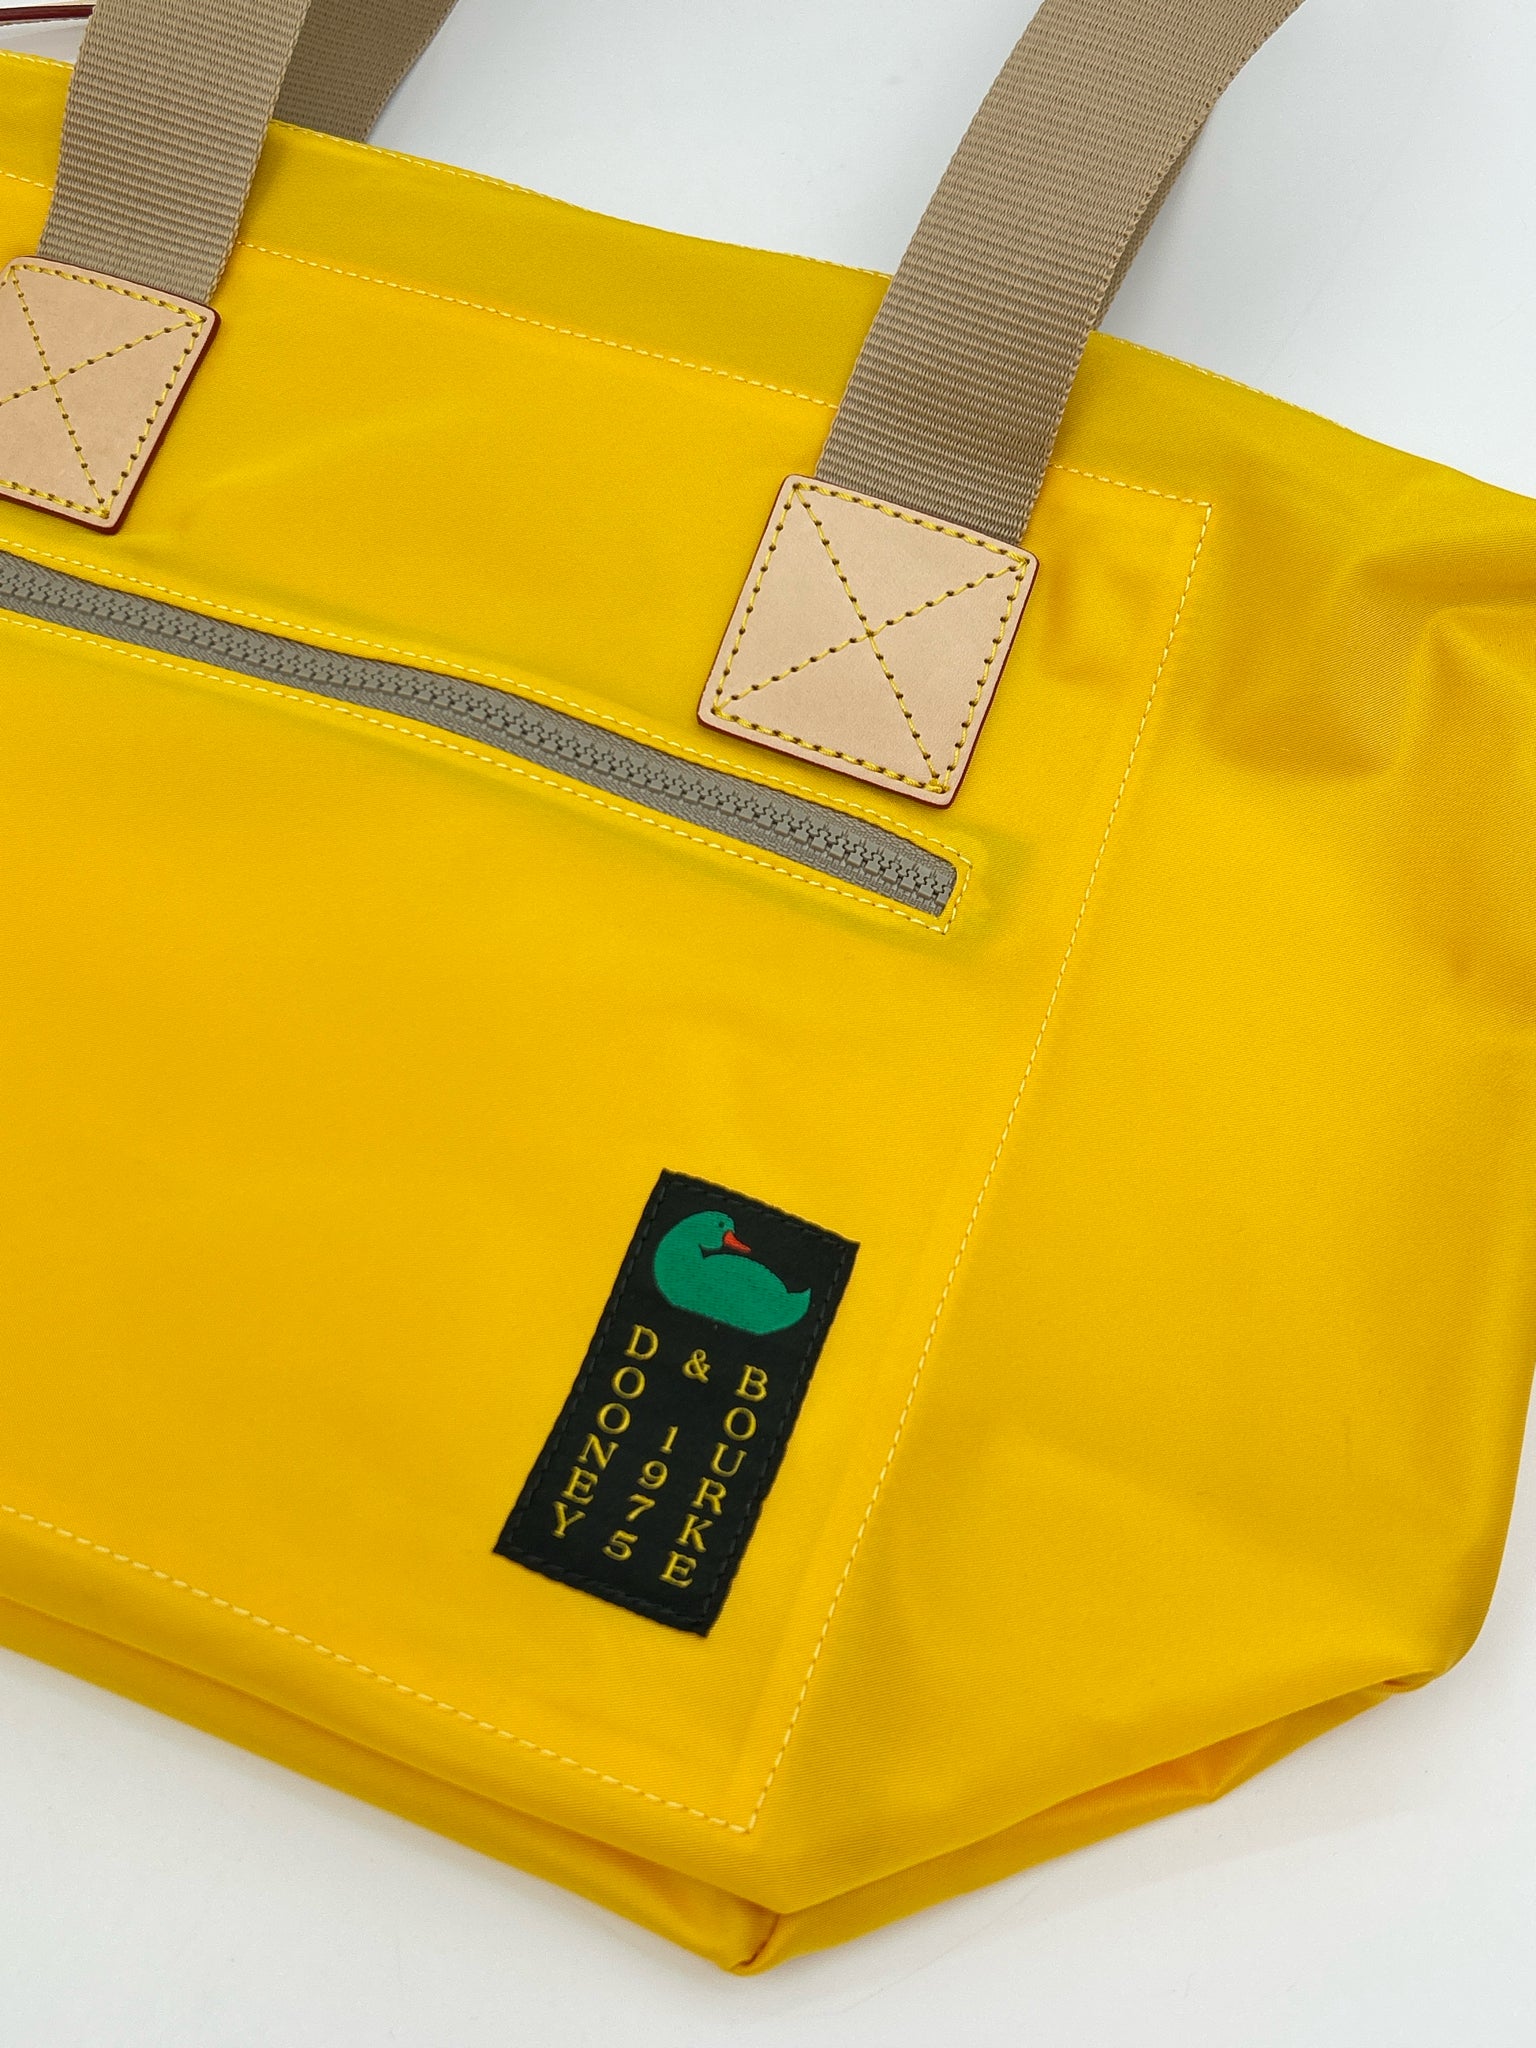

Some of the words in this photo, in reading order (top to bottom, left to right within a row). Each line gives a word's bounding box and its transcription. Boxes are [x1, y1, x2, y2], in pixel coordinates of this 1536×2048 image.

[551, 1324, 659, 1539] DOONEY
[682, 1349, 711, 1383] &
[603, 1425, 679, 1562] 1975
[660, 1364, 768, 1588] BOURKE
